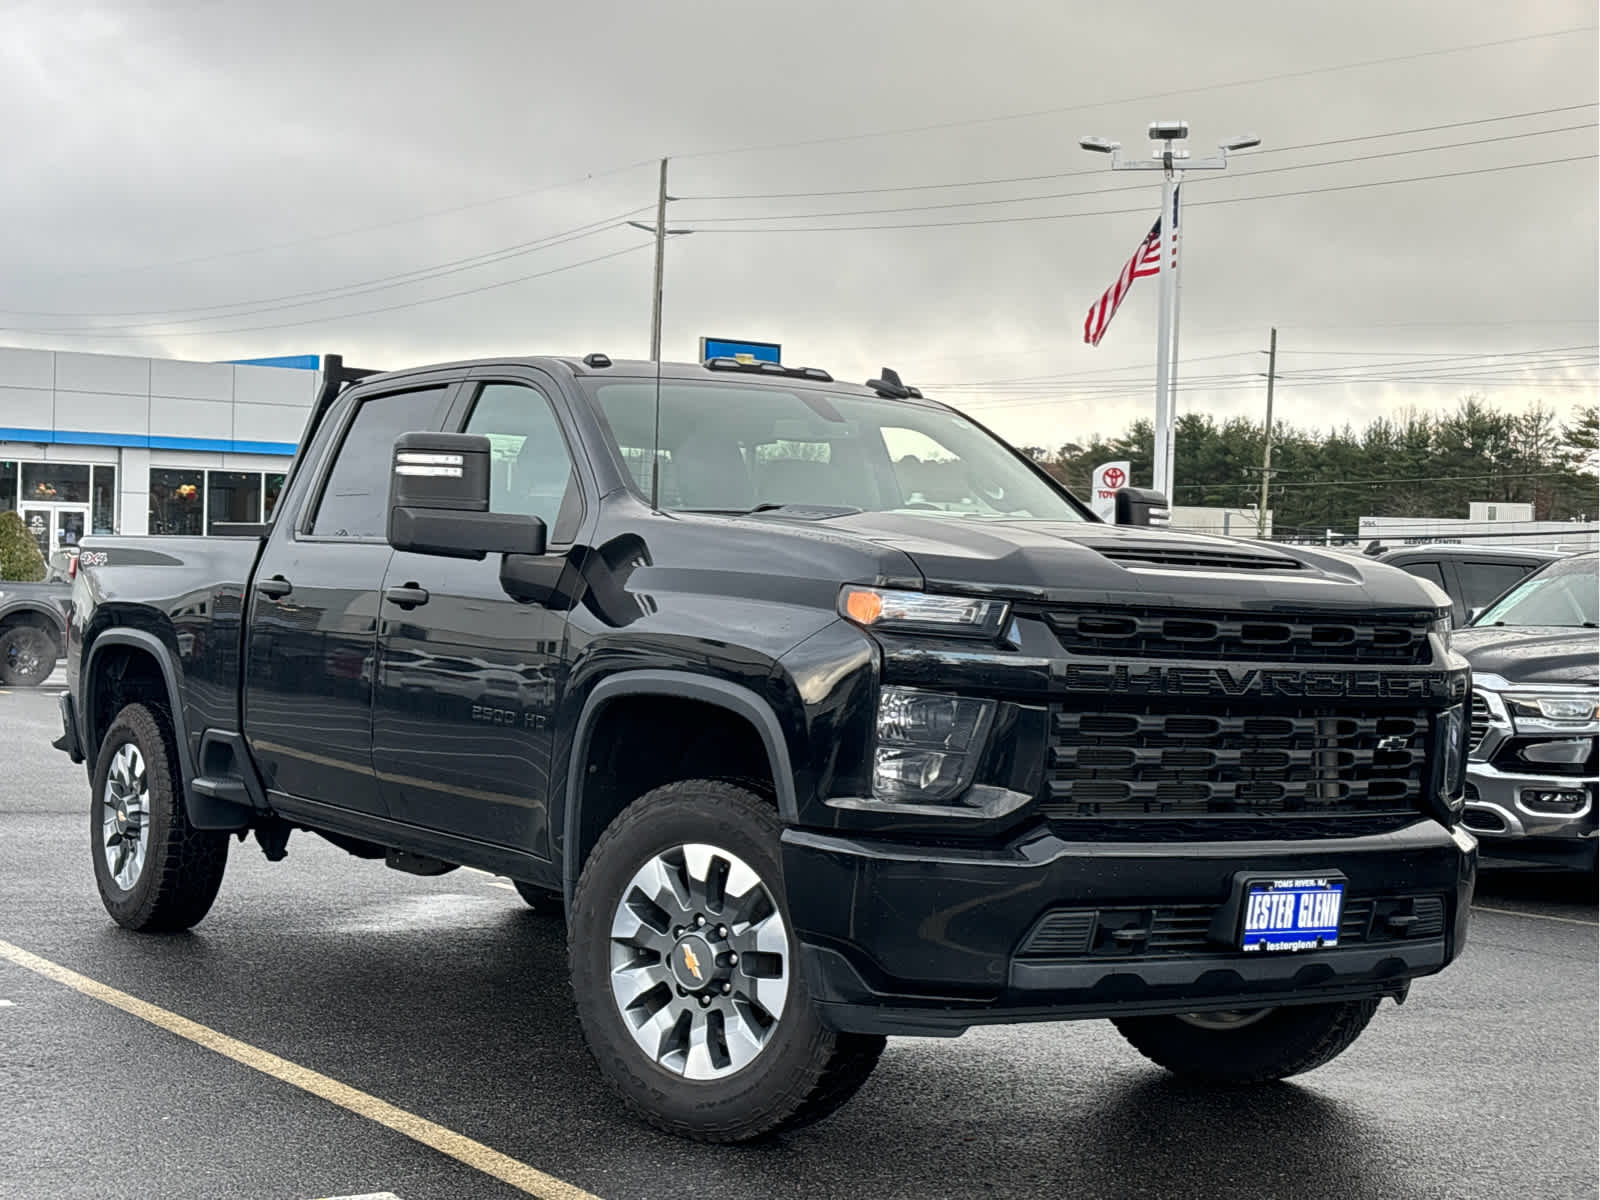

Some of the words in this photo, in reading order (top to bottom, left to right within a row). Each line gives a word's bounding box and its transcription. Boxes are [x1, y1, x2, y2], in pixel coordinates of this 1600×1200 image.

[1097, 490, 1117, 499] TOY
[1066, 662, 1445, 698] CHEVROLET
[472, 705, 516, 724] 2500
[525, 713, 547, 728] HD
[1274, 880, 1293, 888] TOMS
[1245, 894, 1296, 930] LESTER
[1298, 893, 1342, 928] GLENN
